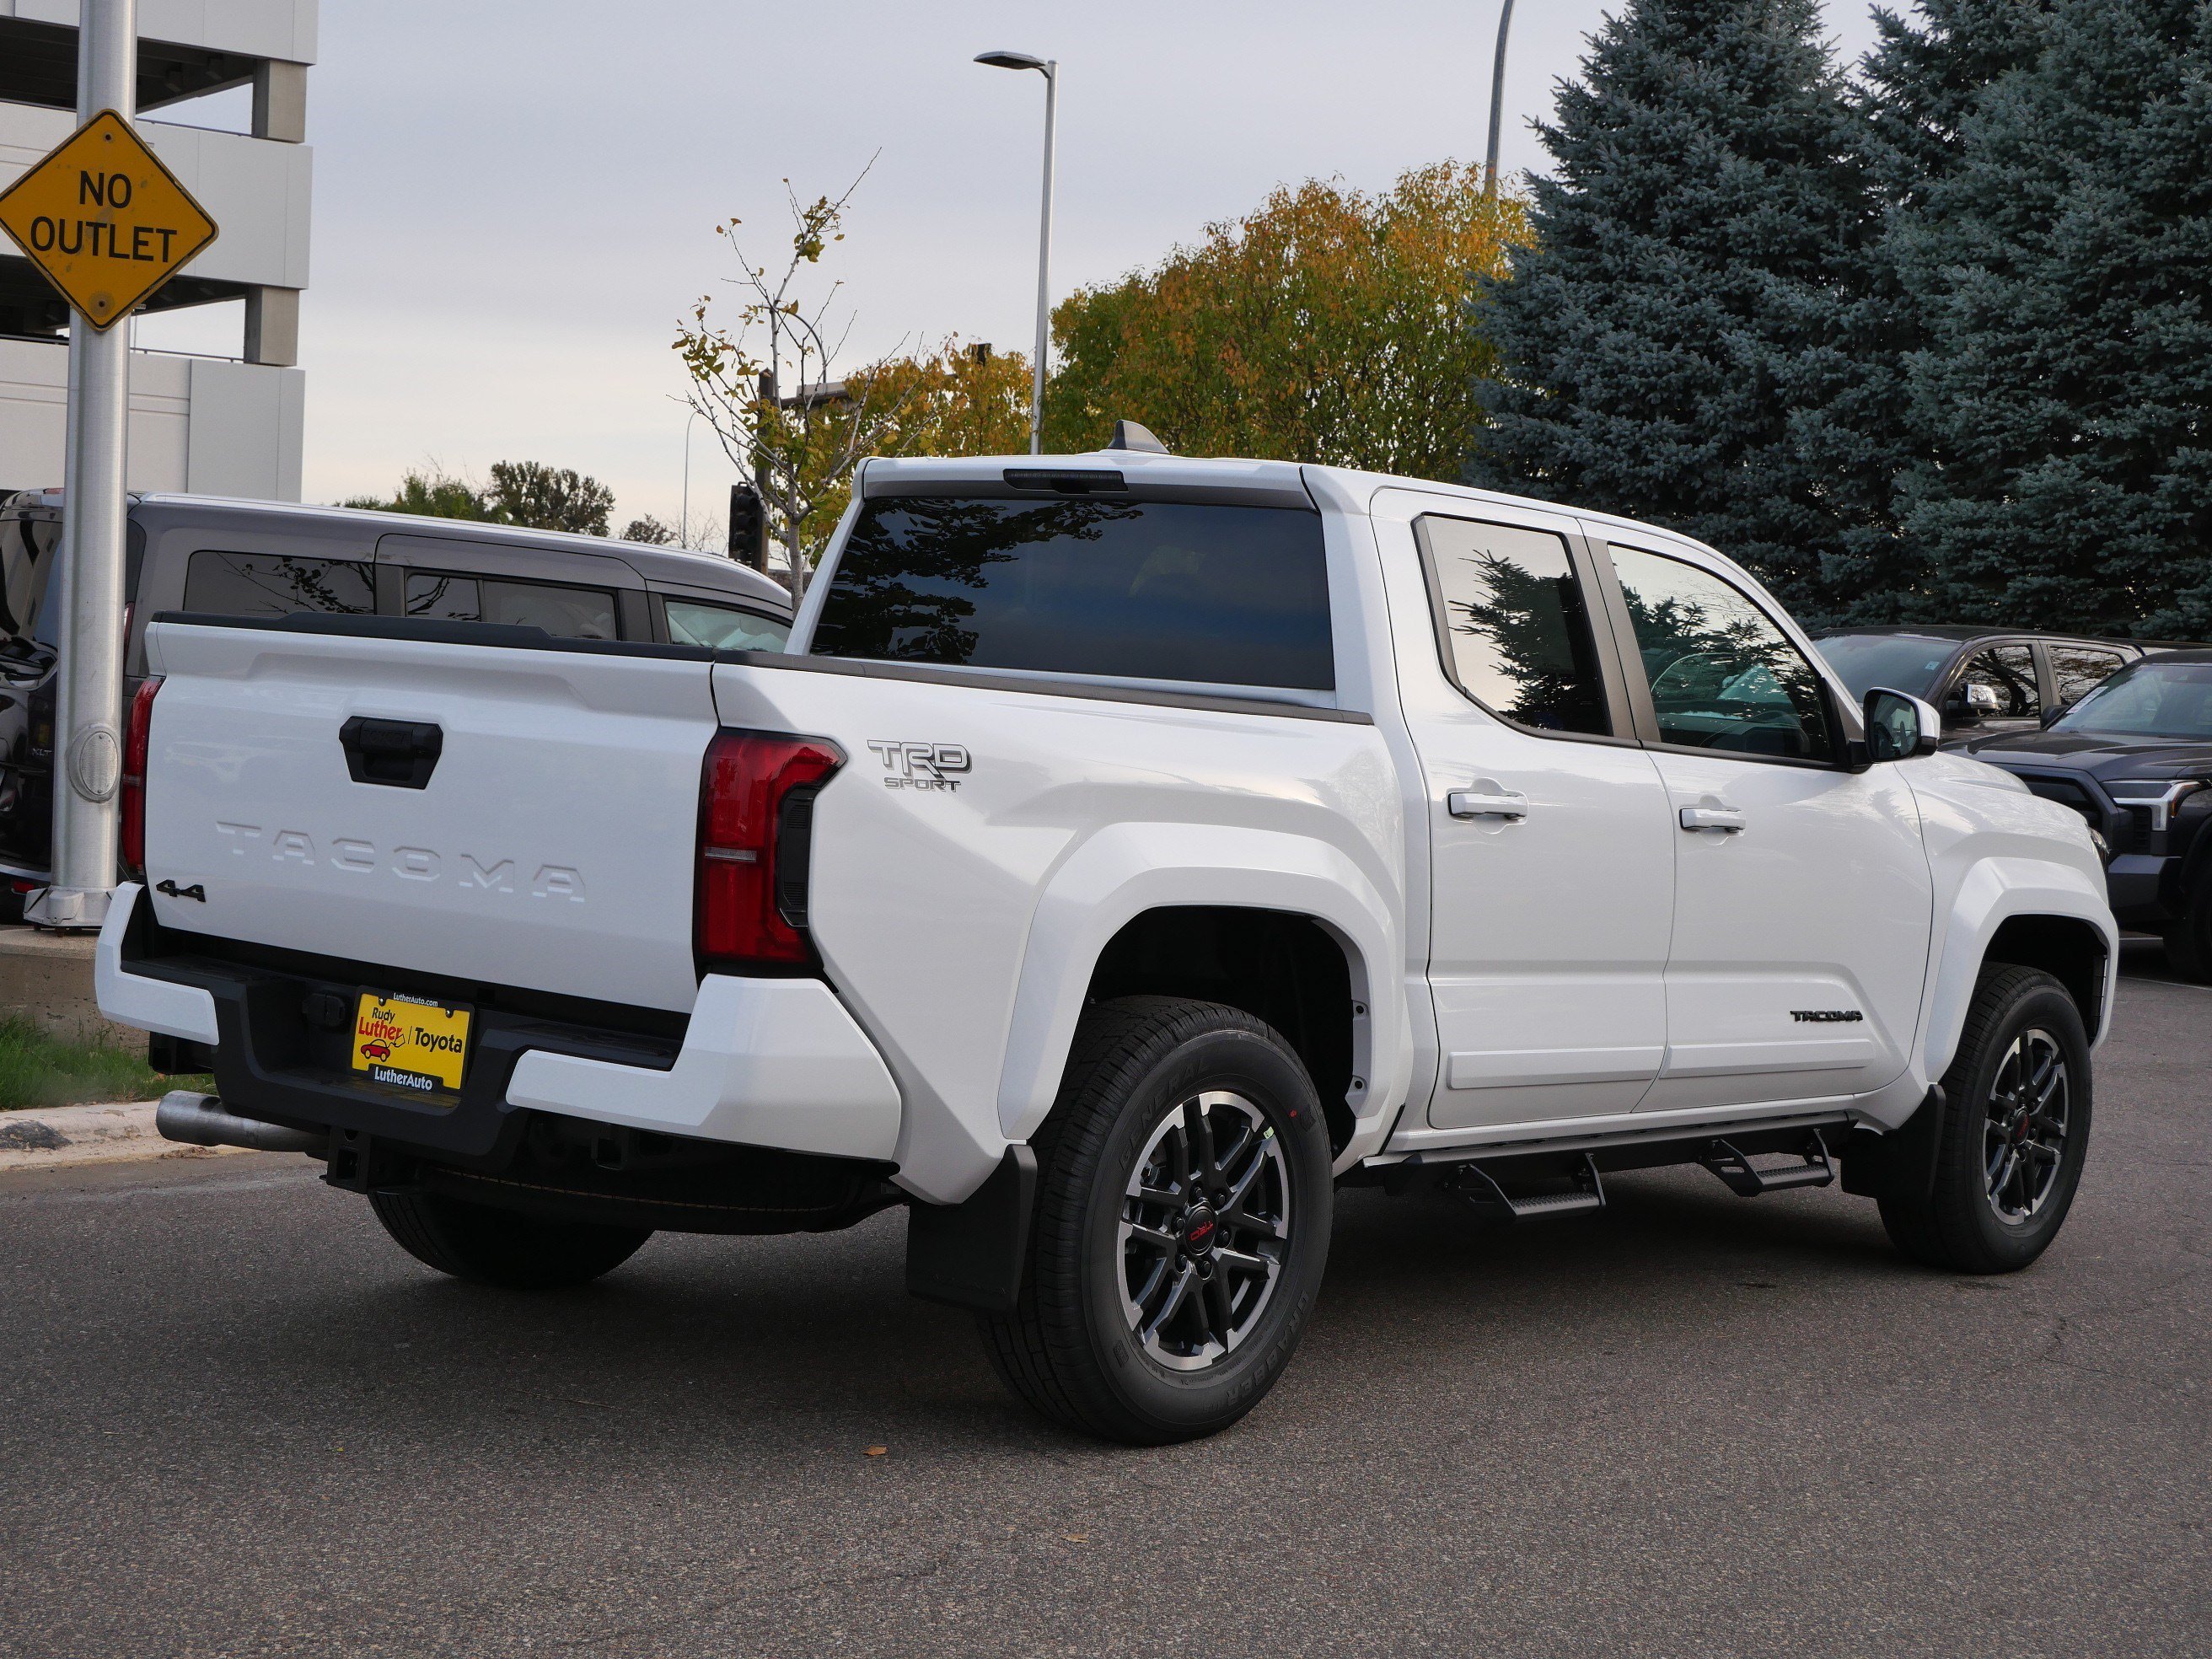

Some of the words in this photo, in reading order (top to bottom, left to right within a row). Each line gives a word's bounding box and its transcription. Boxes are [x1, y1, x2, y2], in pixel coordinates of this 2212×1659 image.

[79, 170, 132, 208] NO
[30, 216, 177, 263] OUTLET
[32, 748, 52, 757] XLT
[867, 739, 972, 779] TRD
[883, 776, 962, 793] SPORT
[216, 820, 586, 904] TACOMA
[393, 992, 438, 1007] LutherAuto.com
[372, 1007, 395, 1024] Rudy
[1789, 1010, 1864, 1022] TACOMA
[358, 1017, 403, 1040] Luther
[414, 1027, 463, 1054] Toyota
[374, 1066, 433, 1091] LutherAuto
